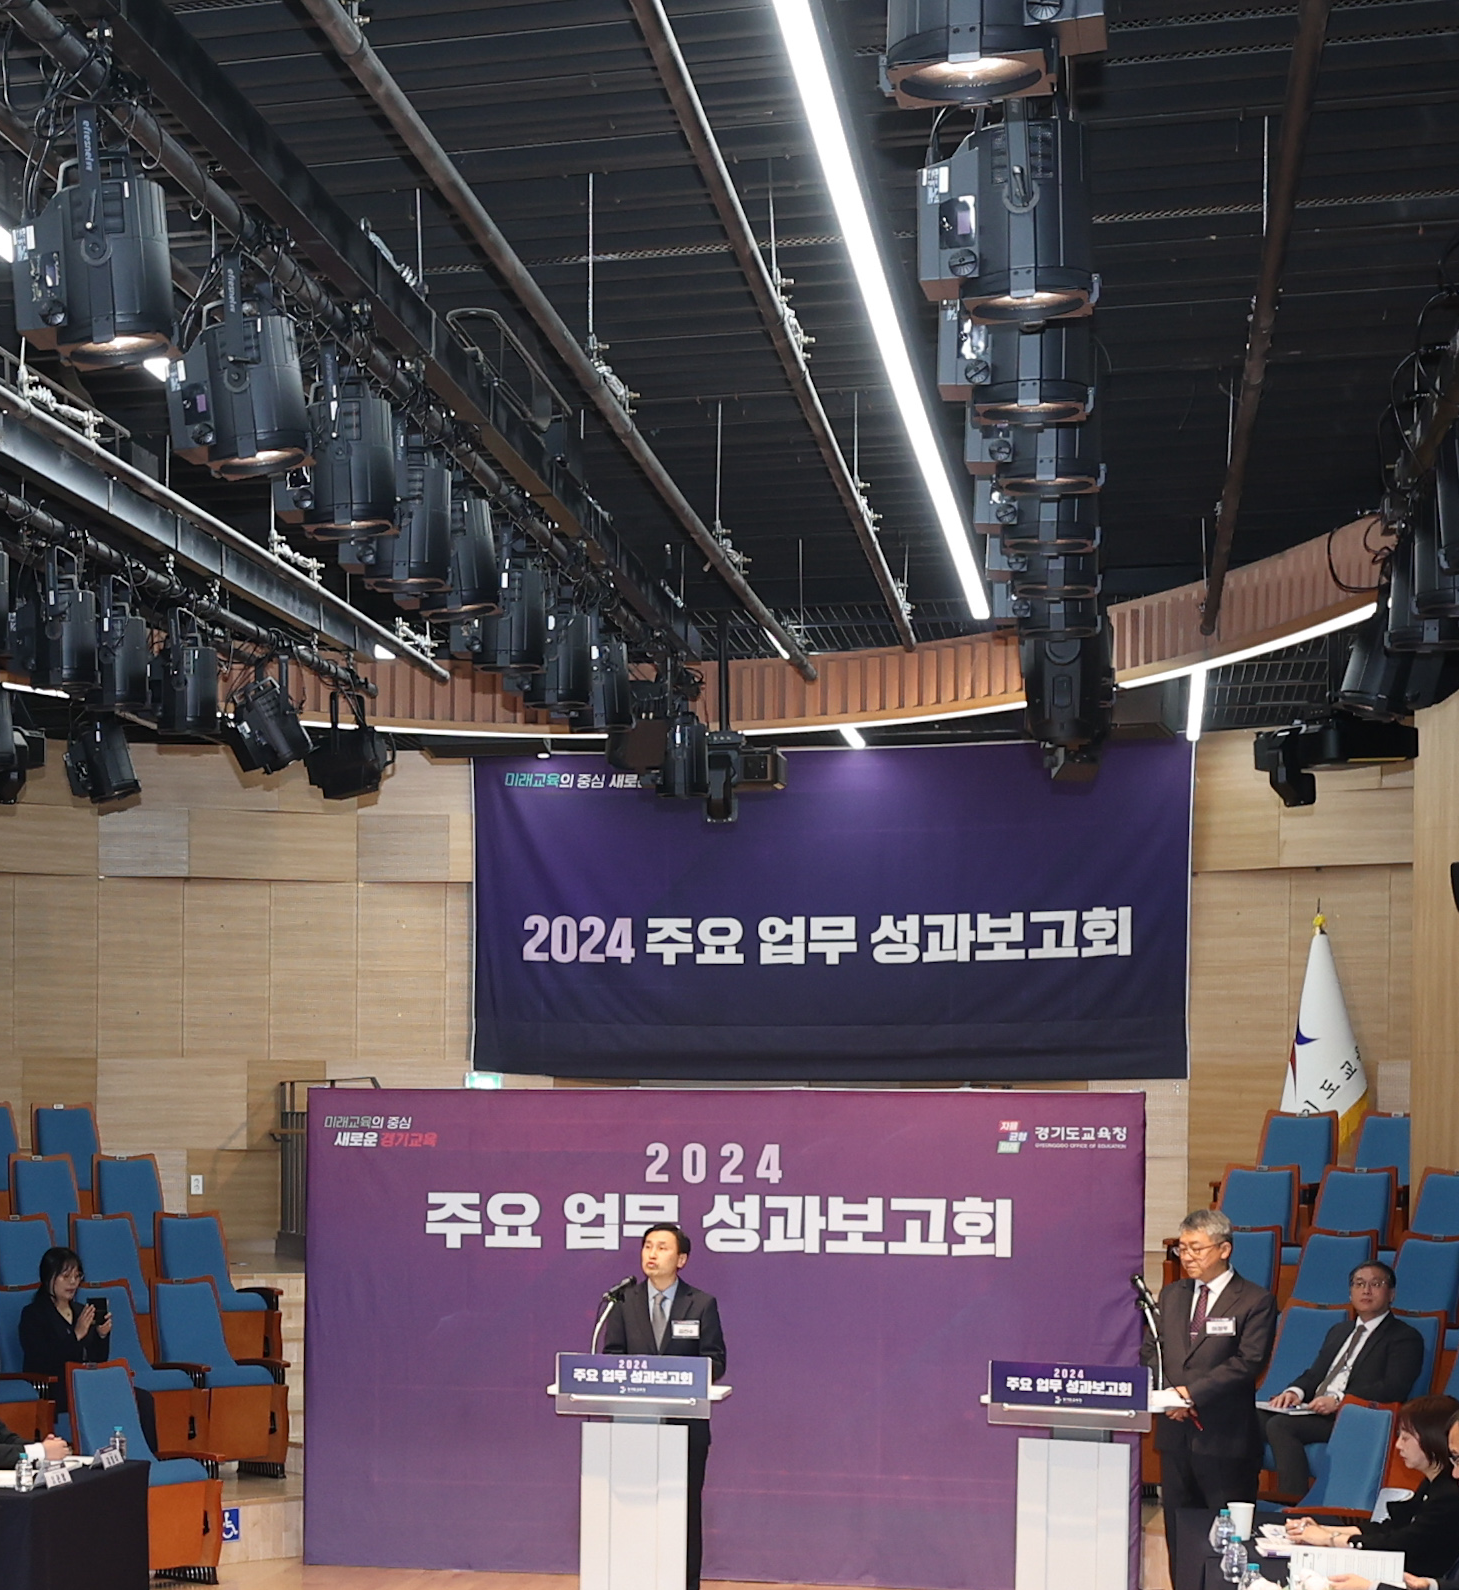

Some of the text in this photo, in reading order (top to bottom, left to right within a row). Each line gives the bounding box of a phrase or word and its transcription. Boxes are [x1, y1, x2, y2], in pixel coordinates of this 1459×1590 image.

[504, 772, 643, 788] 미래교육의 중심 새로
[522, 906, 1133, 965] 2024 주요 업무 성과보고회
[324, 1115, 412, 1129] 미래교육의 중심
[334, 1132, 438, 1147] 새로운 경기교육
[1034, 1126, 1127, 1141] 경기도교육청
[645, 1143, 783, 1184] 2024
[425, 1191, 1012, 1258] 주요 업무 성과보고회
[618, 1359, 648, 1370] 2024
[573, 1368, 693, 1385] 주요 업무 성과보고회
[1053, 1368, 1085, 1379] 2024
[1006, 1377, 1132, 1397] 주요 업무 성과보고회
